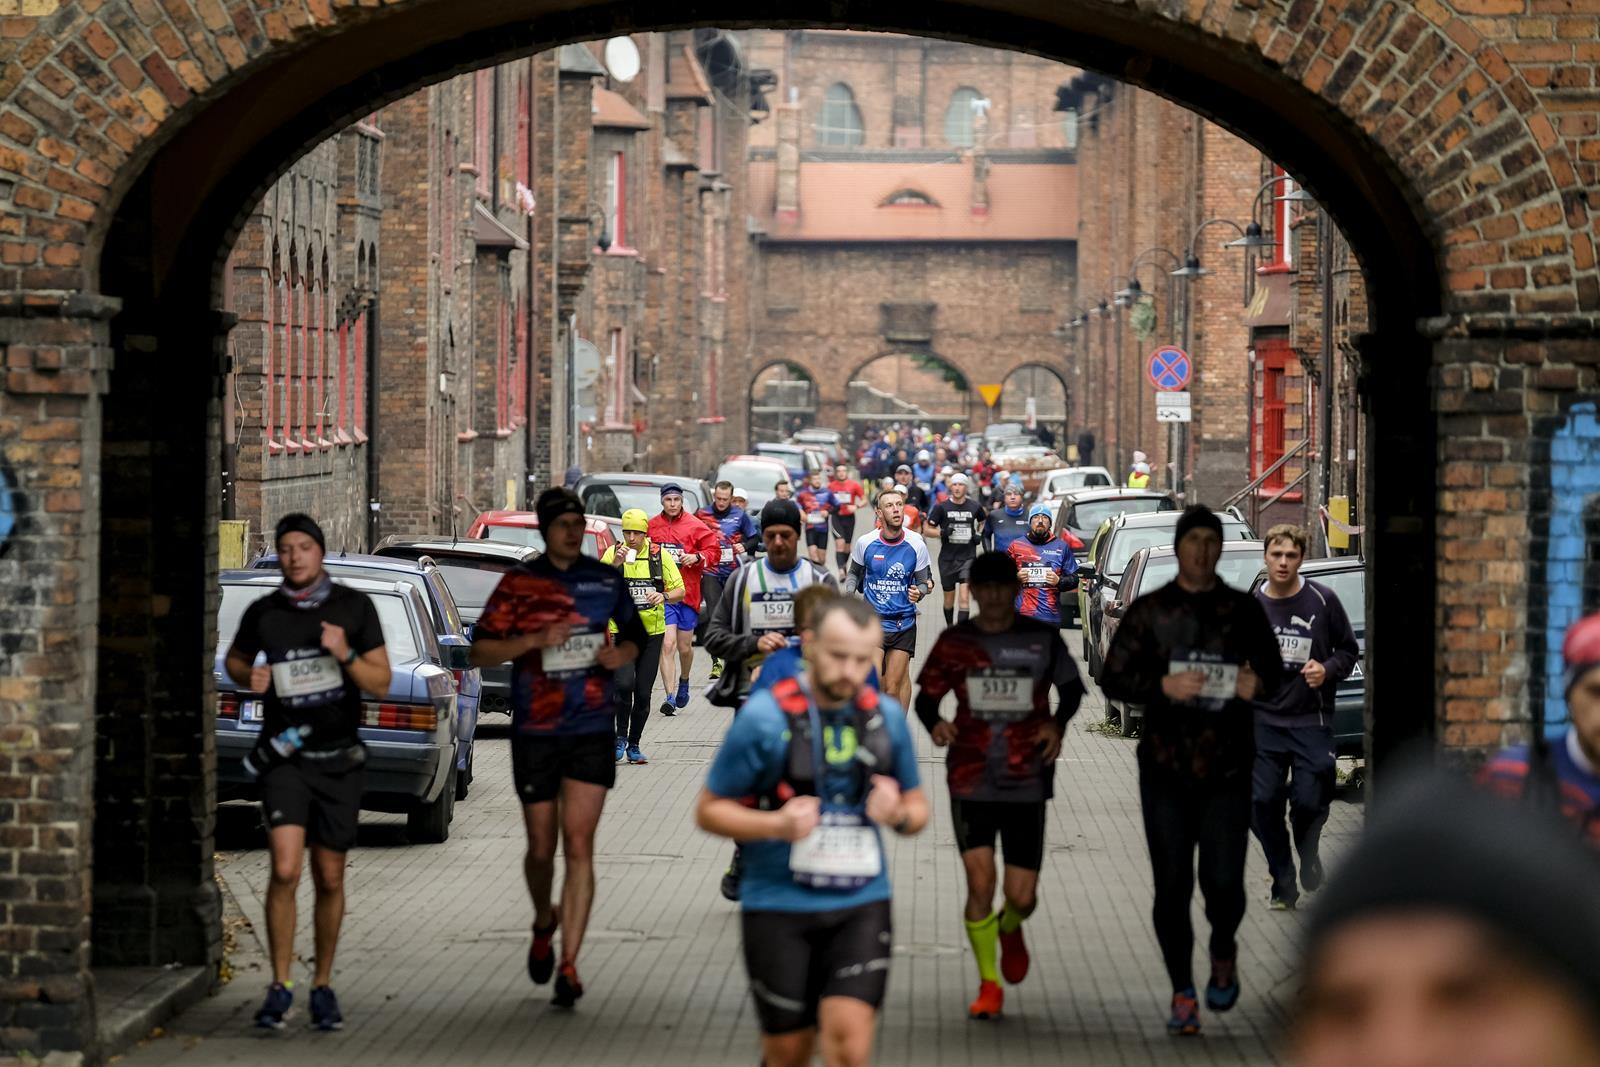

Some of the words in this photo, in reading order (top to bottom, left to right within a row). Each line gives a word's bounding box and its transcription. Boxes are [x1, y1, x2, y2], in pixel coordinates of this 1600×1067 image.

[762, 603, 793, 614] 1597
[289, 659, 322, 677] 806
[982, 680, 1018, 694] 5137
